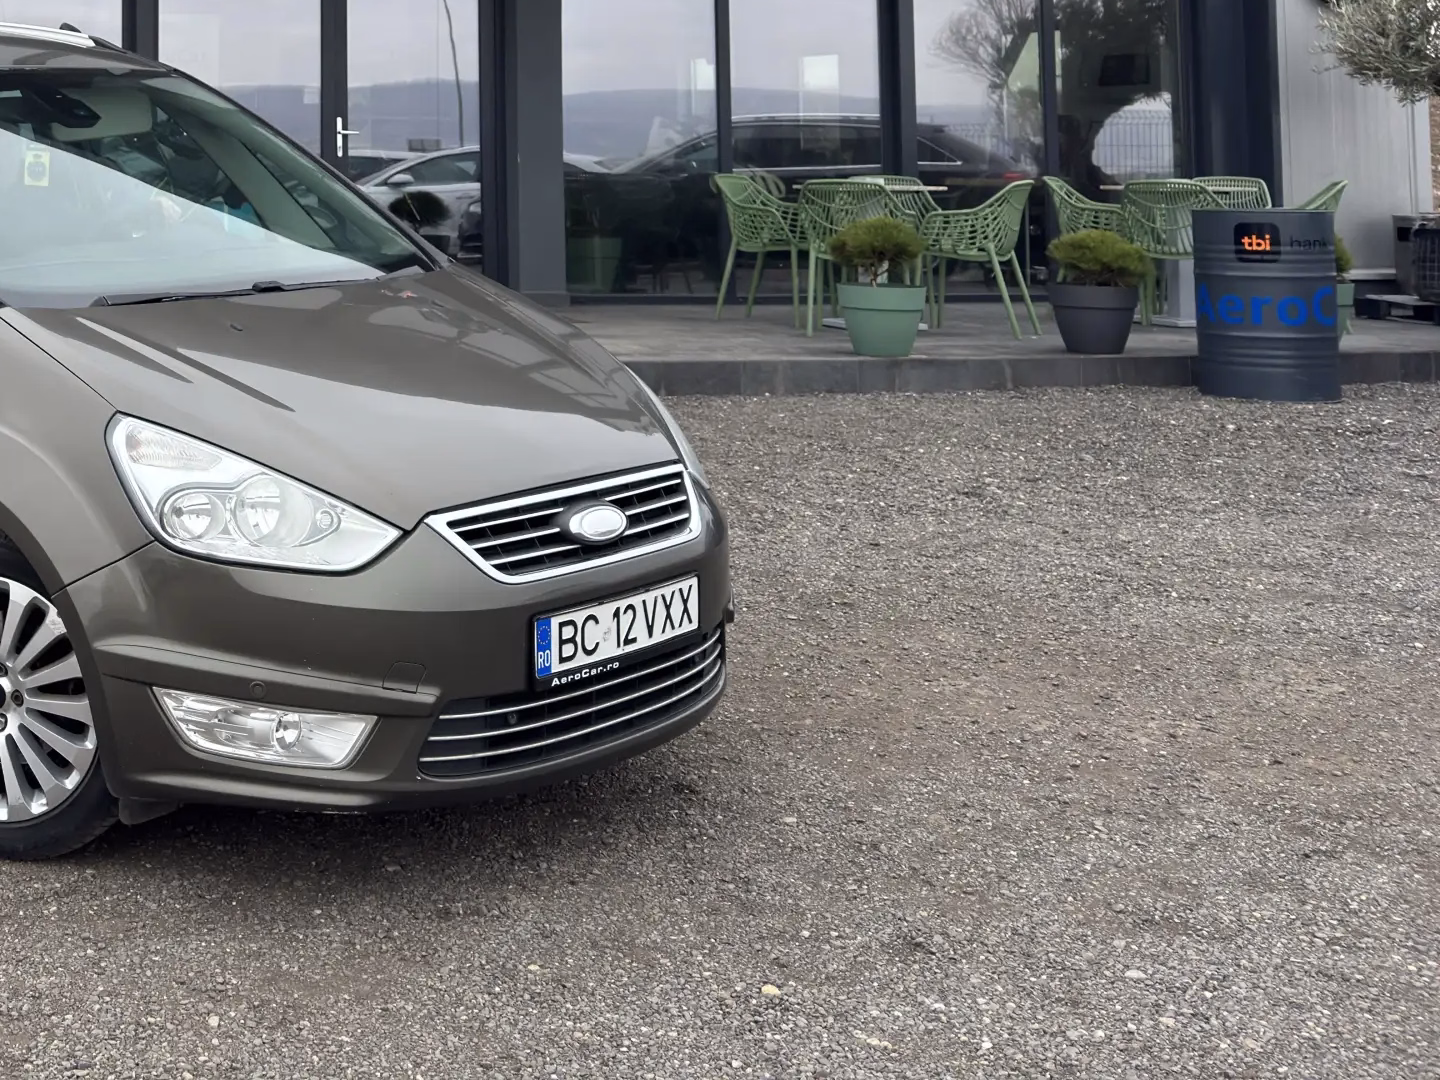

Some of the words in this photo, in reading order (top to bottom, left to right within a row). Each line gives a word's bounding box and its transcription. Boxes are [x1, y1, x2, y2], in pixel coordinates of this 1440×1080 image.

[1242, 234, 1271, 252] tbi
[537, 649, 551, 669] RO
[558, 613, 600, 665] BC
[612, 603, 638, 649] 12
[642, 584, 693, 639] VXX
[551, 661, 620, 687] AeroCar.ro
